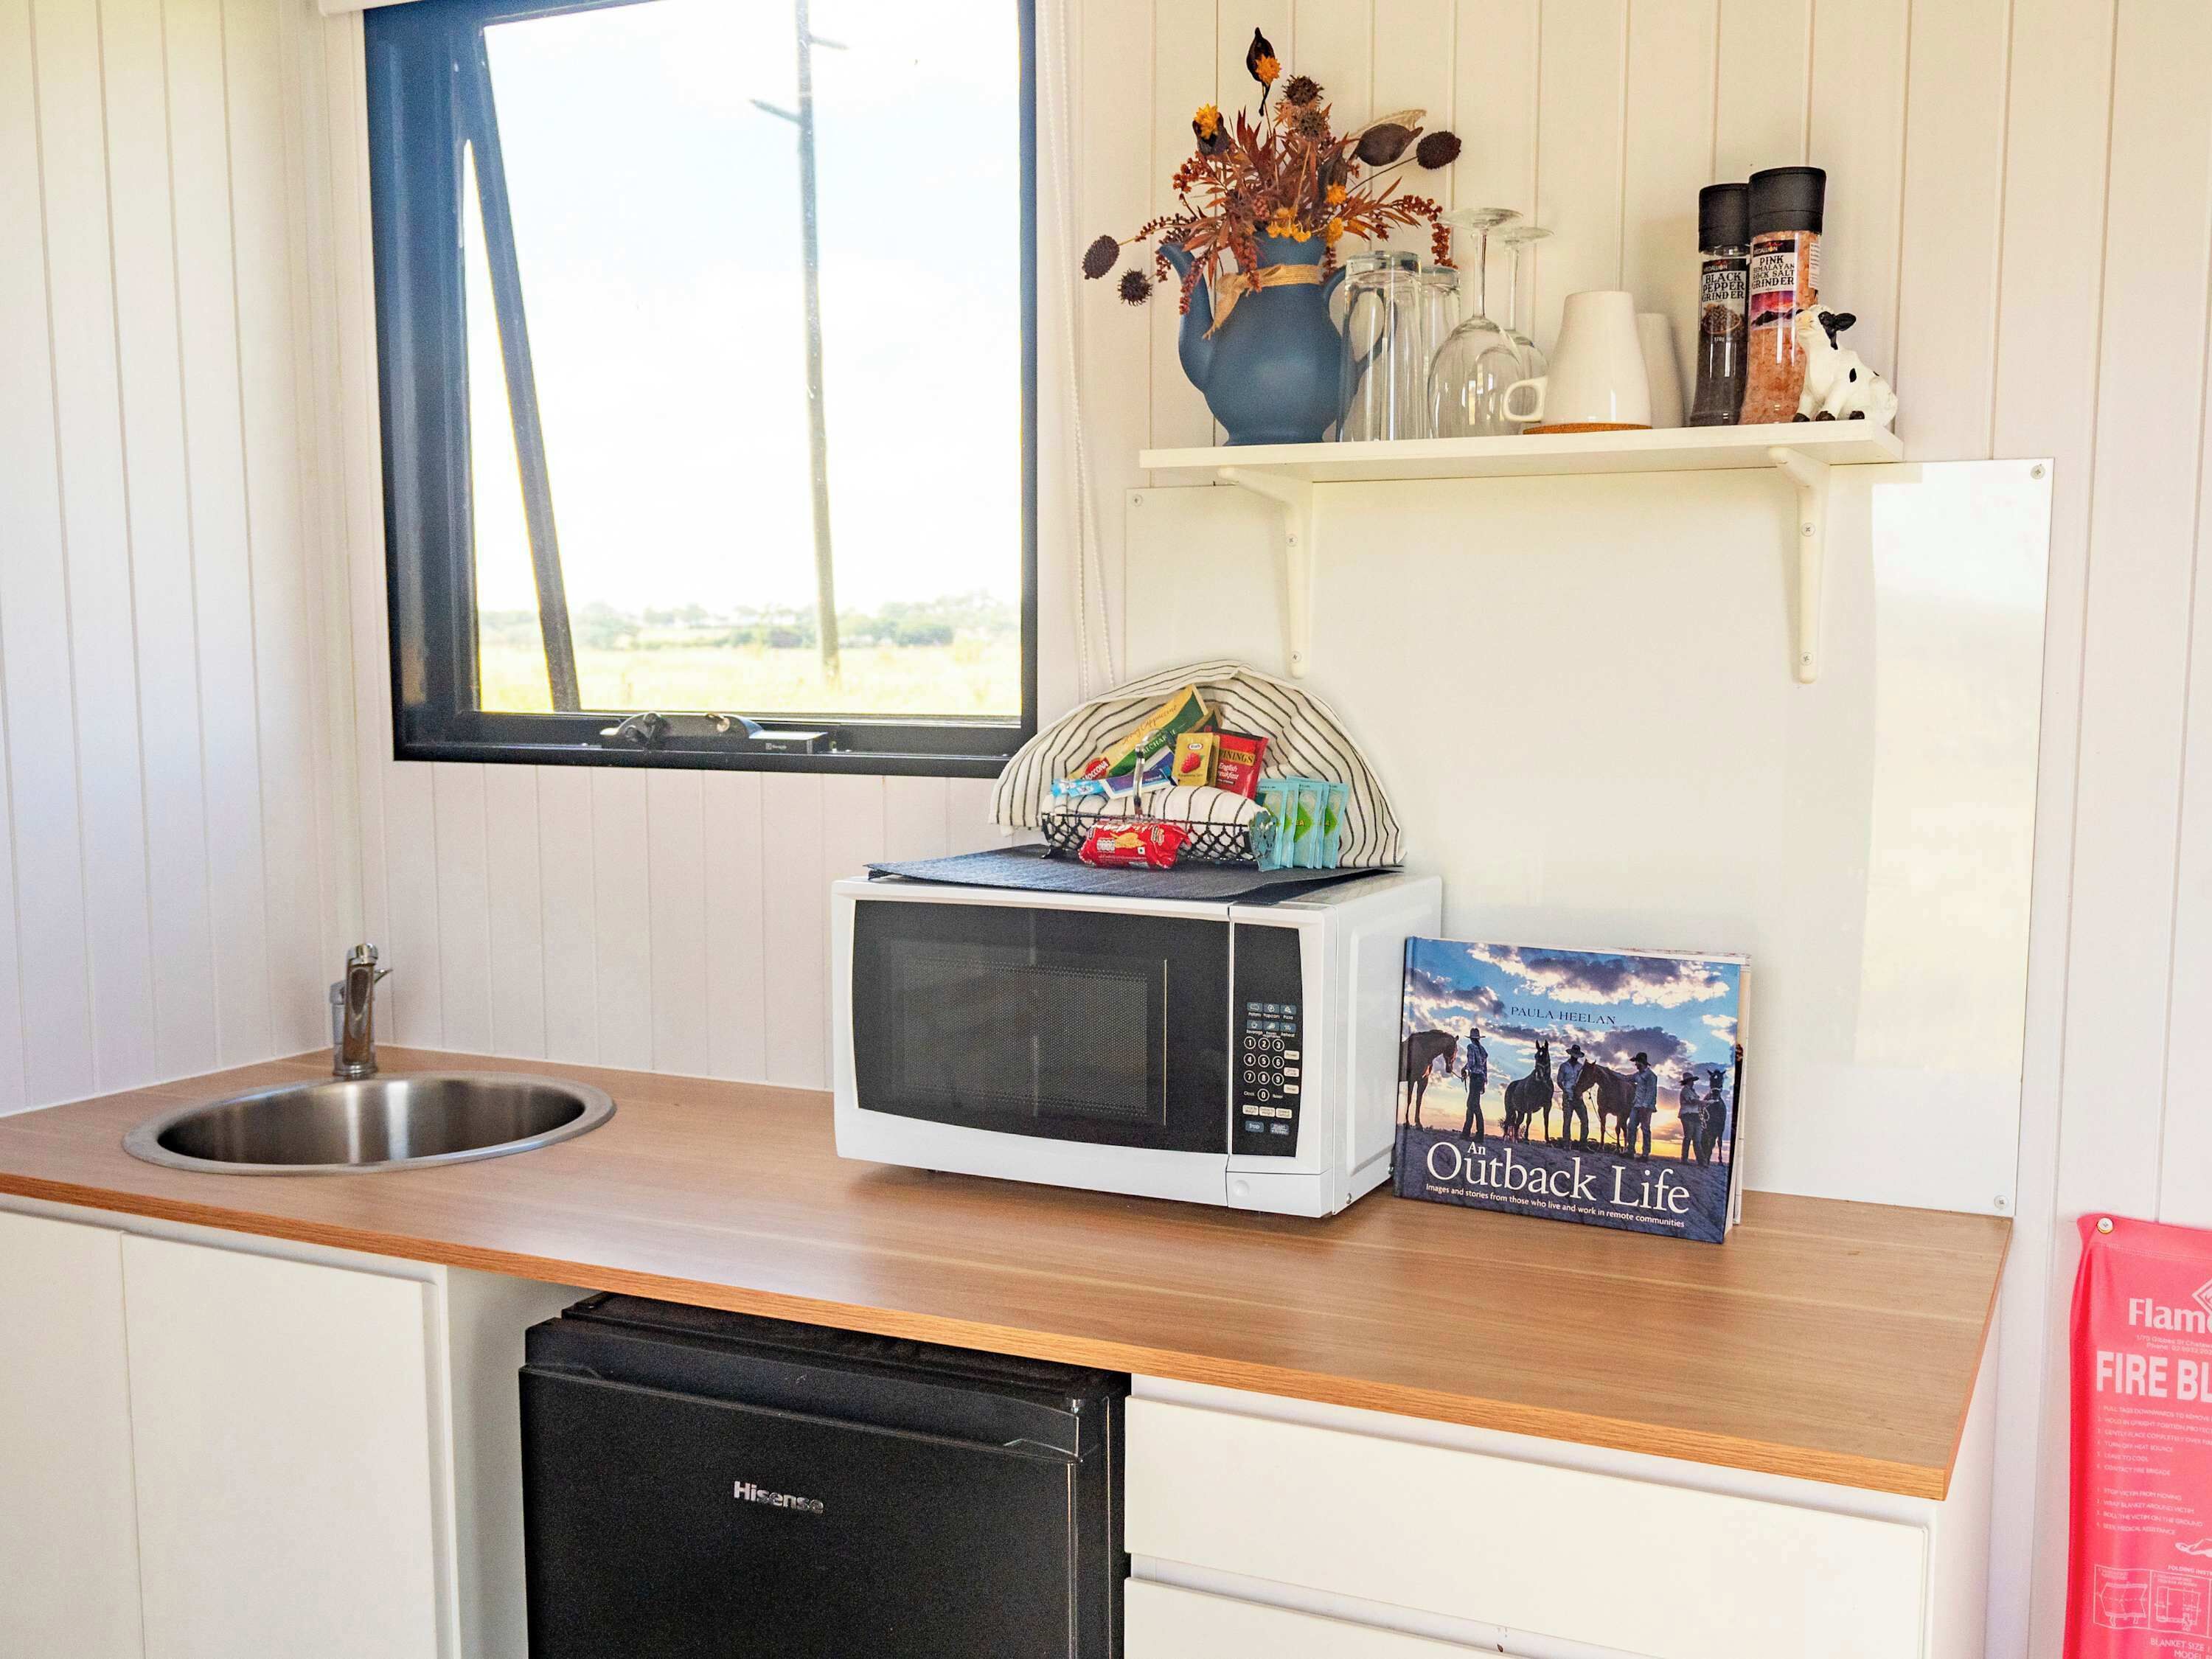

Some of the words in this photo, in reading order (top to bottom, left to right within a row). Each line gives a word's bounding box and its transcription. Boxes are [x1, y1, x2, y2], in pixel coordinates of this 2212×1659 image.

[1760, 255, 1784, 265] PINK
[1705, 272, 1742, 284] BLACK
[1752, 276, 1795, 290] GRINDER
[1703, 281, 1745, 293] PEPPER
[1702, 291, 1745, 302] GRINDER
[1219, 762, 1238, 772] English
[1512, 1007, 1554, 1019] PAULA
[1559, 1011, 1615, 1024] HEELAN
[1467, 1141, 1486, 1155] An
[1427, 1141, 1597, 1201] Outback
[1610, 1165, 1690, 1214] Life
[1426, 1183, 1450, 1194] Images
[1450, 1187, 1464, 1196] and
[1466, 1189, 1489, 1199] stories
[1490, 1192, 1507, 1203] from
[1509, 1196, 1529, 1205] those
[1531, 1199, 1547, 1208] who
[1548, 1200, 1561, 1210] live
[1562, 1203, 1576, 1212] and
[1578, 1206, 1596, 1215] work
[1607, 1211, 1635, 1221] remote
[1635, 1215, 1685, 1228] communities
[2096, 1351, 2168, 1398] FIRE
[2134, 1408, 2174, 1418] DOWNWARDS
[2185, 1413, 2210, 1422] REMOVE
[733, 1481, 824, 1514] Hisense
[2167, 1565, 2194, 1573] FOLDING
[2149, 1637, 2187, 1649] BLANKET
[2188, 1641, 2205, 1652] SIZE
